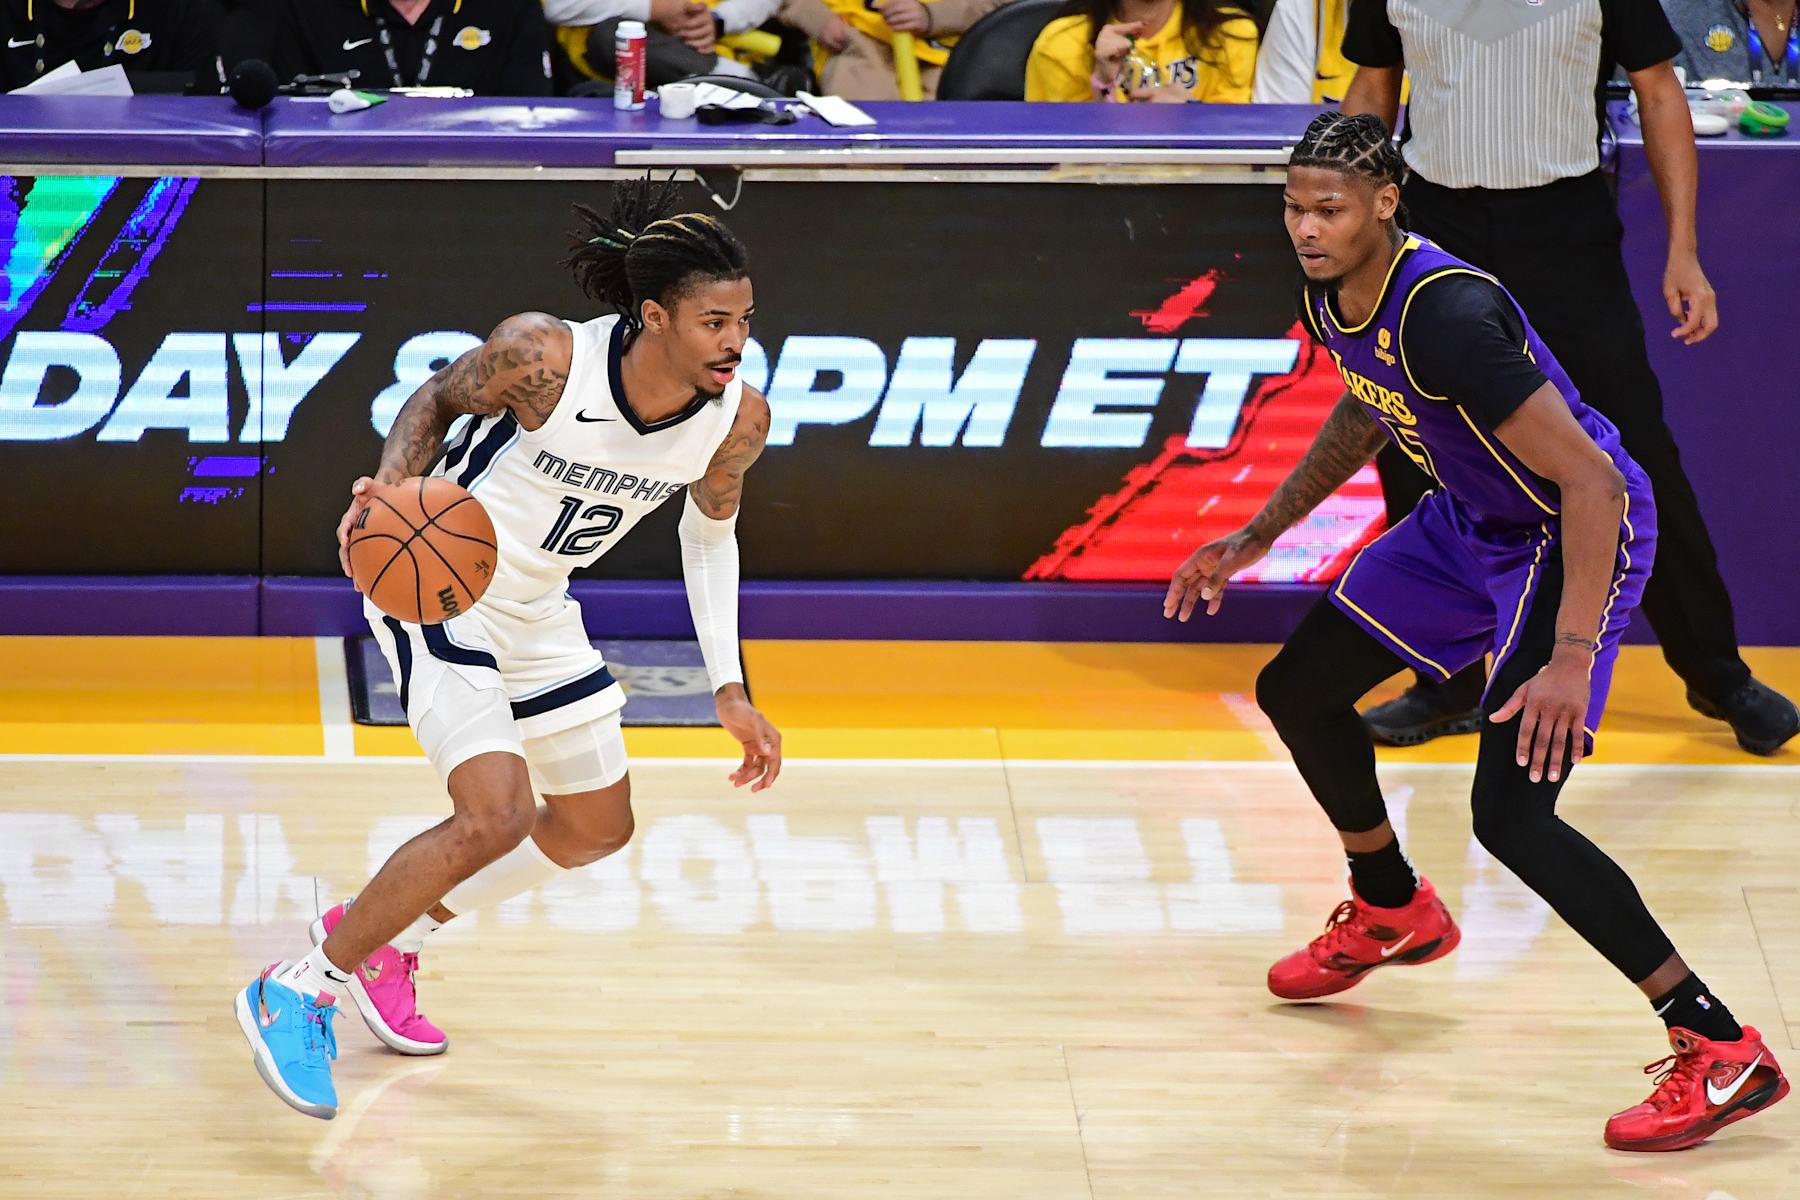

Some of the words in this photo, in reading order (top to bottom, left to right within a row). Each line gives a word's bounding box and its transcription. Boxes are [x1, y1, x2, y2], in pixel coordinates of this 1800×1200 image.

[0, 331, 362, 443] DAY
[736, 336, 1038, 448] PM
[1040, 337, 1302, 449] ET
[533, 450, 686, 502] MEMPHIS
[540, 495, 624, 556] 12
